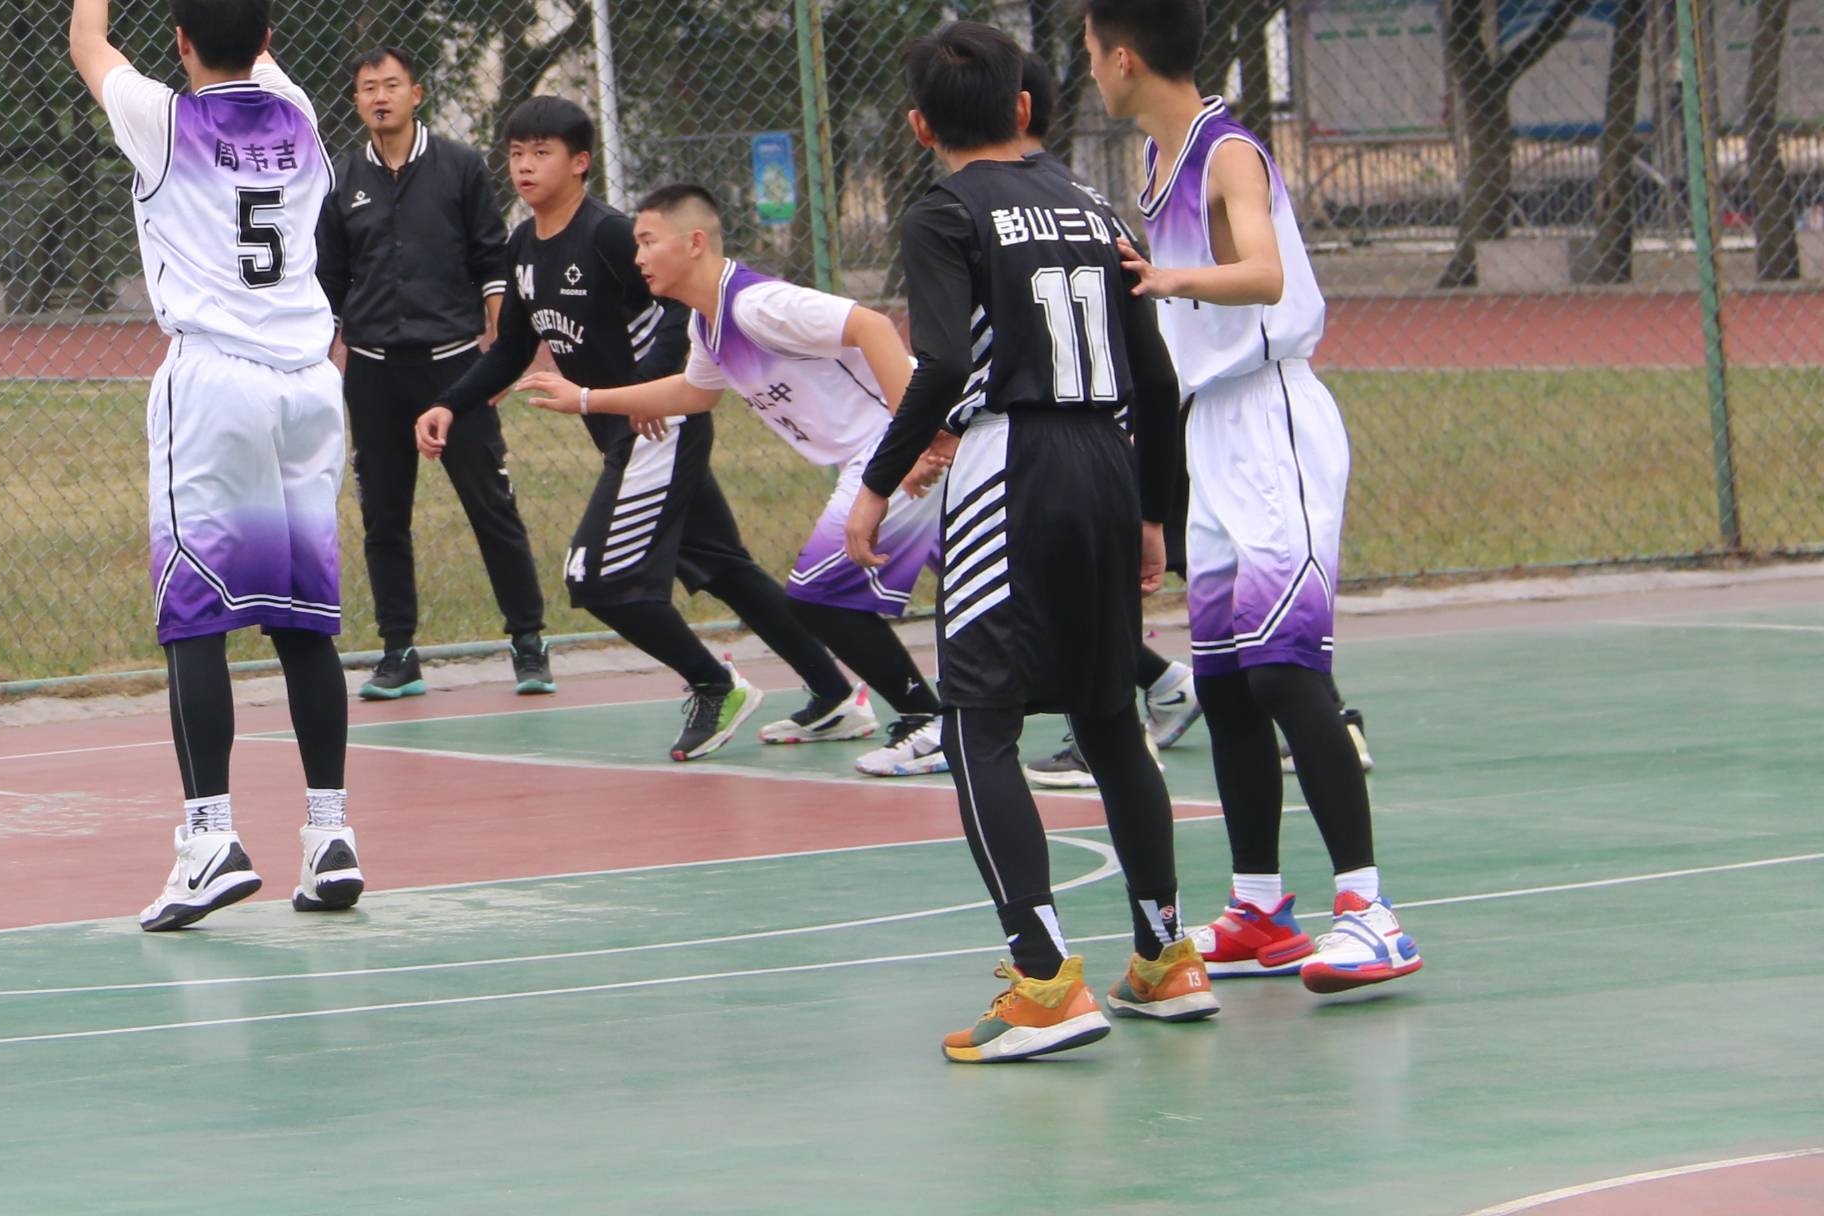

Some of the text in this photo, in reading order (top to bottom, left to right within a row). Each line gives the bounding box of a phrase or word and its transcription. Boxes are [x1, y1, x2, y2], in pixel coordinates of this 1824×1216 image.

[214, 138, 298, 172] 周韦吉
[235, 186, 286, 289] 5
[991, 206, 1111, 246] 彭山三中
[1031, 266, 1118, 403] 11
